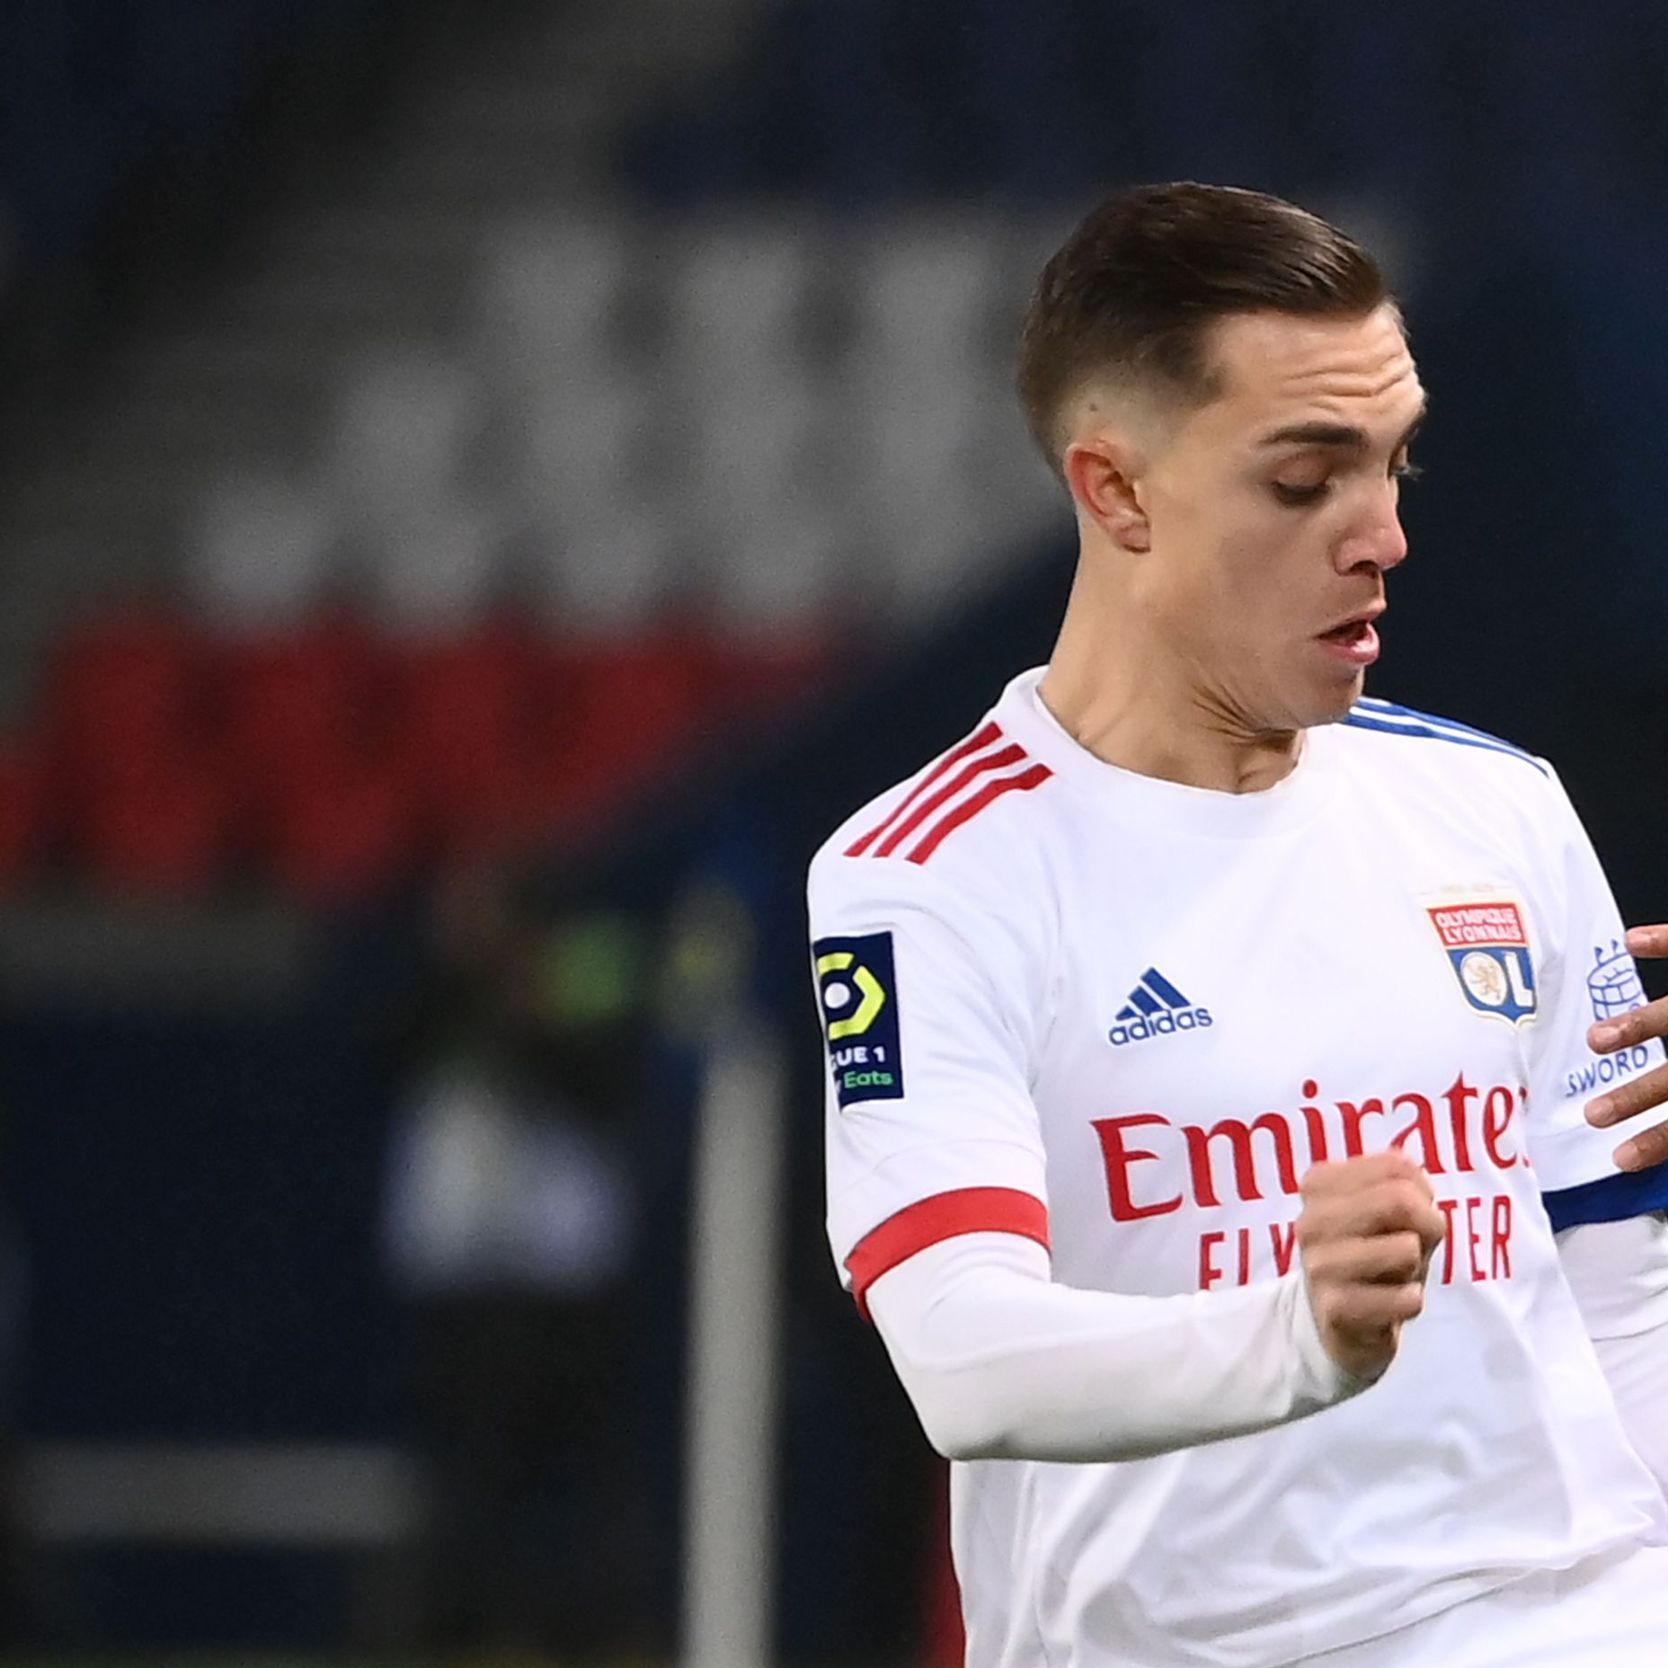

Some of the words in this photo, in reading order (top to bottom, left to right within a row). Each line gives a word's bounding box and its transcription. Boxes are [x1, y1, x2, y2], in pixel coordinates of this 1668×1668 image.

[1435, 908, 1517, 929] OLYMPIQUE
[1443, 924, 1522, 943] LYONNAIS
[1108, 1007, 1213, 1046] adidas
[844, 1071, 894, 1089] Eats
[1566, 1045, 1648, 1098] SWORD
[1089, 1070, 1530, 1222] Emirate
